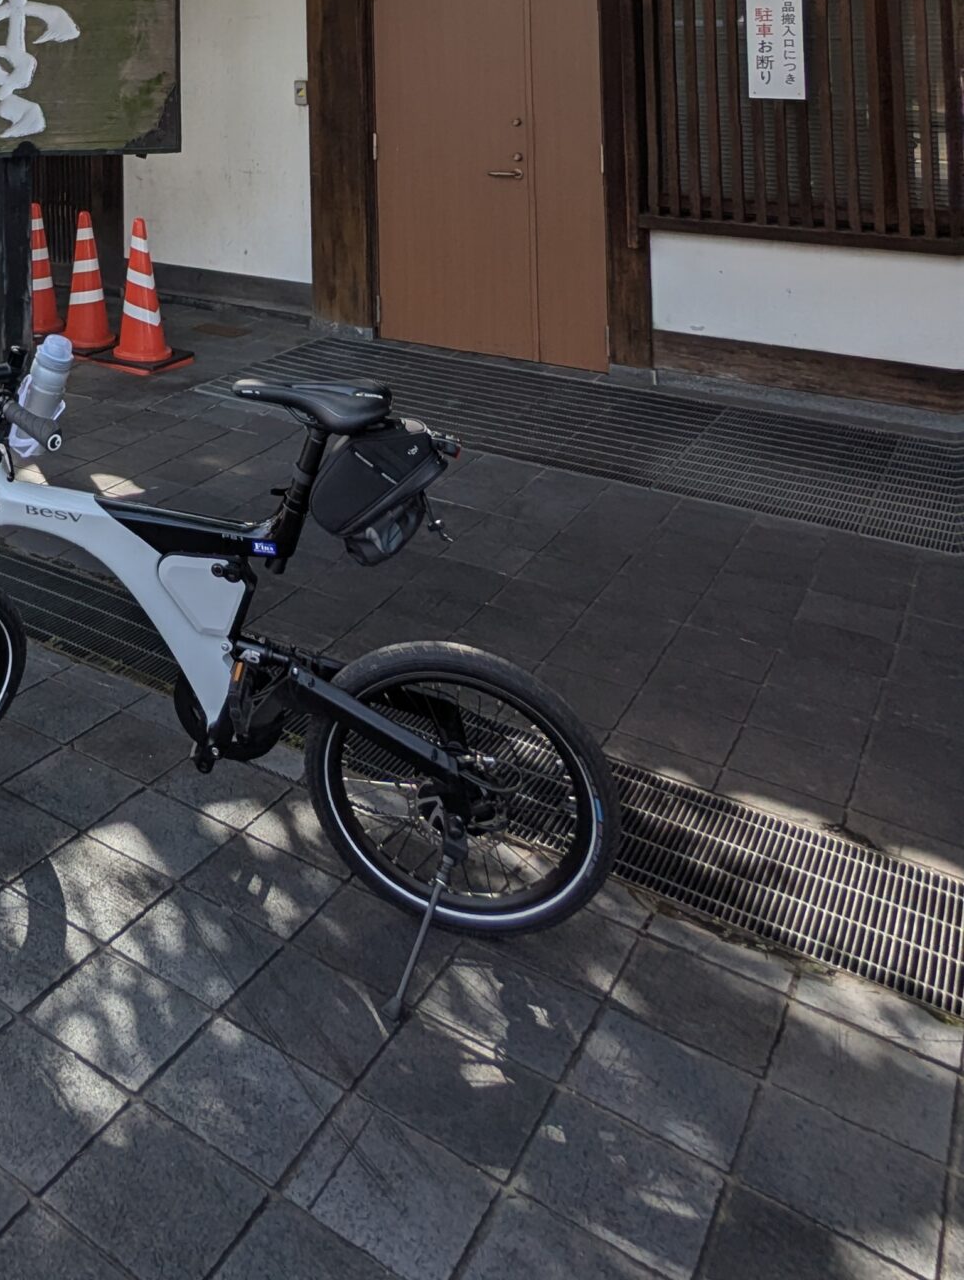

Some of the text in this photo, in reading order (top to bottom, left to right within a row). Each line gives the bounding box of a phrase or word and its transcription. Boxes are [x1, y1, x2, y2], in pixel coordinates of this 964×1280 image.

[754, 7, 775, 86] 駐車お断り
